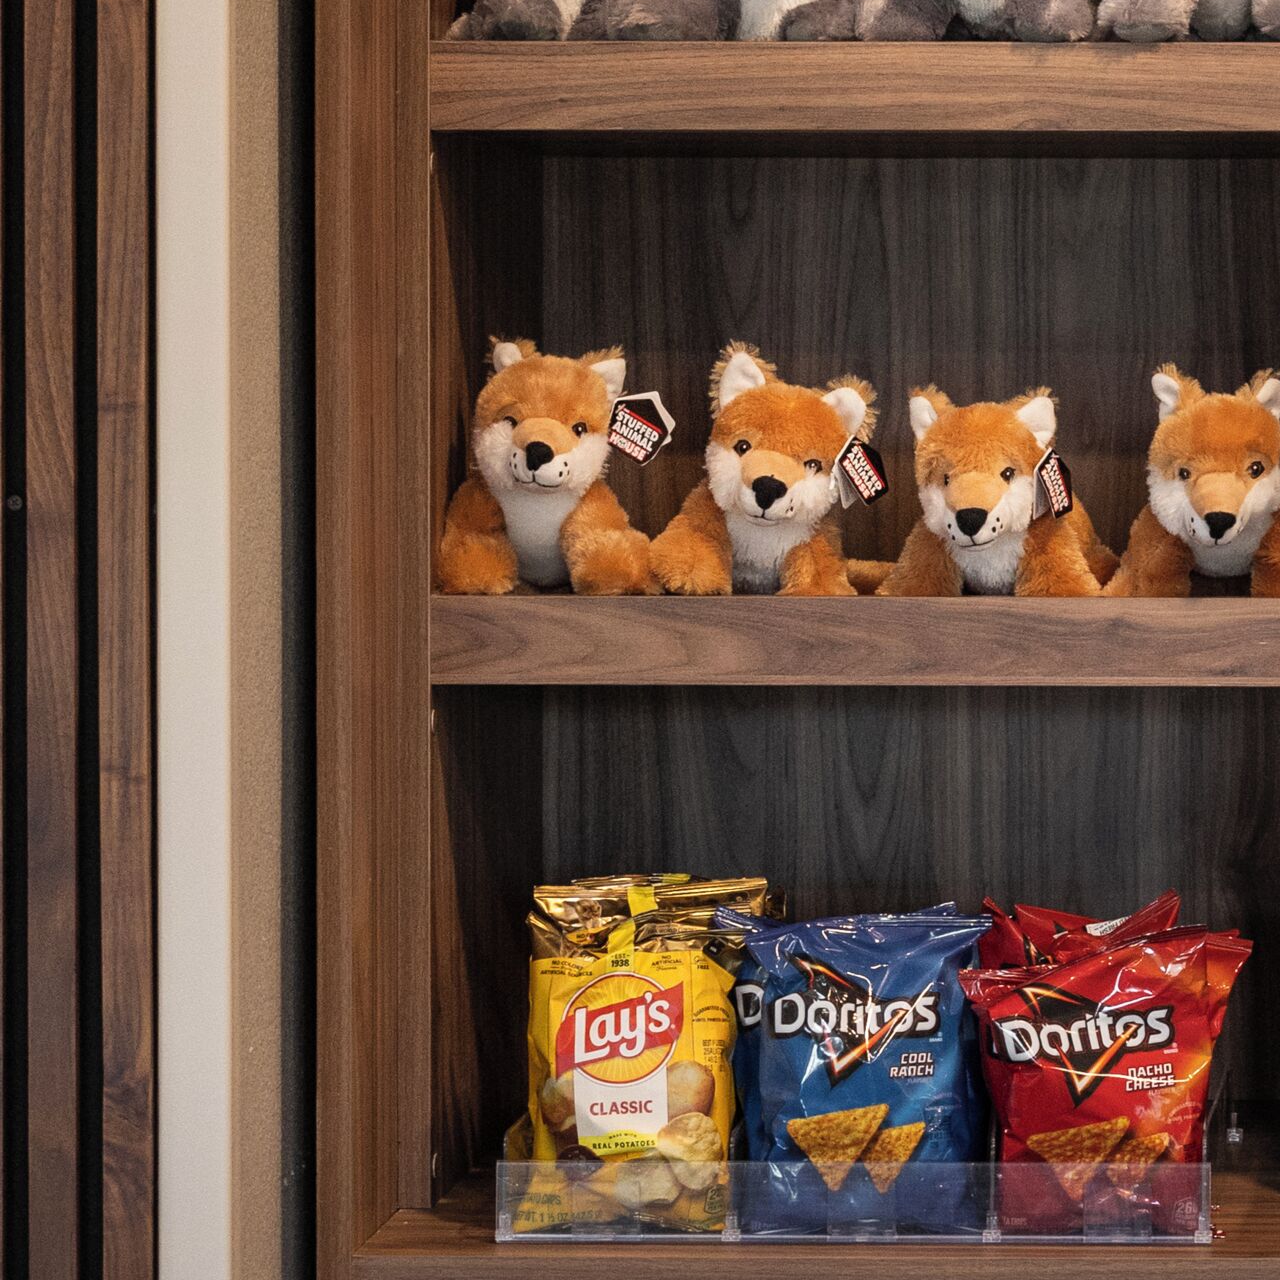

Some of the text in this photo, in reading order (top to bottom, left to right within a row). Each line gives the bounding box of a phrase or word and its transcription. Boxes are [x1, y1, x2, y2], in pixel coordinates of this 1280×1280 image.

[611, 420, 653, 452] ANIMAL
[615, 410, 660, 442] STUFFED
[608, 431, 648, 461] HOUSE
[846, 452, 876, 496] ANIMAL
[851, 445, 883, 491] STUFFED
[611, 959, 630, 968] 1938
[574, 991, 671, 1064] Lay's
[774, 992, 937, 1035] Doritos
[1001, 1008, 1171, 1062] Doritos
[890, 1065, 934, 1077] RANCH
[901, 1052, 933, 1064] COOL
[1127, 1063, 1173, 1078] NACHO
[1125, 1075, 1175, 1091] CHEESE
[589, 1100, 653, 1116] CLASSIC
[592, 1140, 656, 1150] REAL POTATOES
